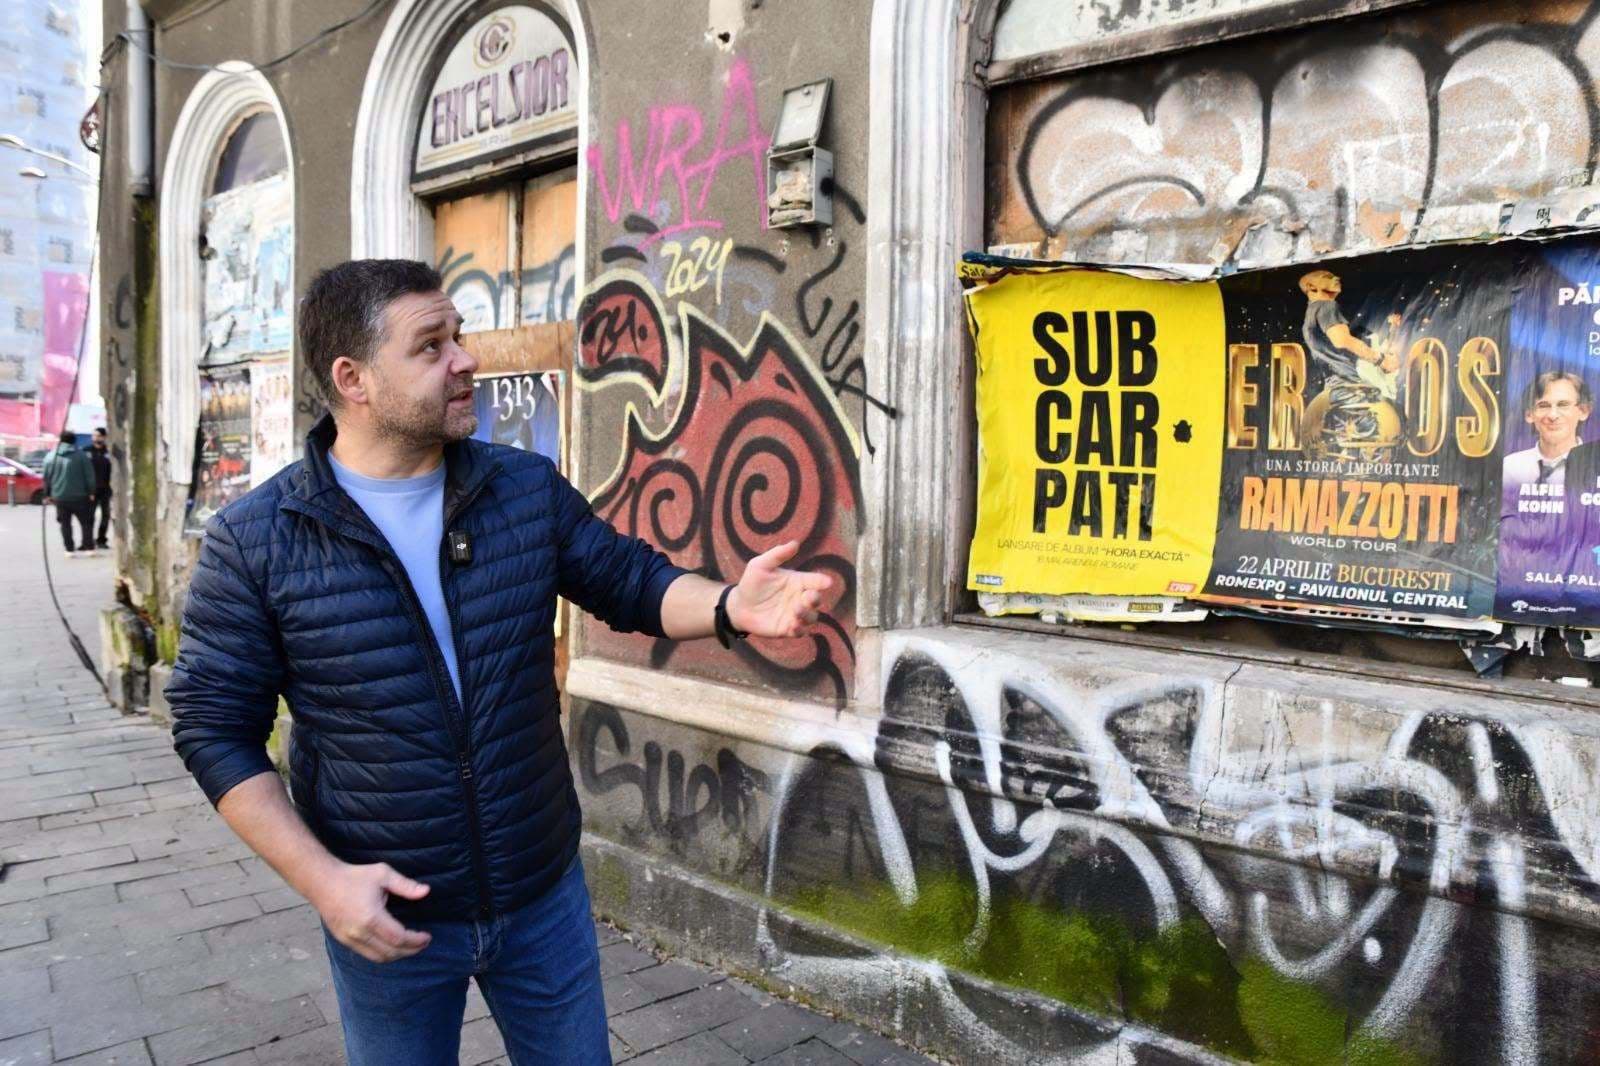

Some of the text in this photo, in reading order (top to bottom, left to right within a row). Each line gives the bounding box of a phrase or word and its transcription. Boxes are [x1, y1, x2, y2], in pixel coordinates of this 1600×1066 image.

[431, 48, 569, 148] EXCELSIOR
[661, 236, 733, 305] 2024
[1032, 310, 1158, 387] SUB
[491, 375, 536, 421] 1313
[1227, 336, 1501, 458] EROS
[1035, 389, 1160, 468] CAR
[1266, 459, 1440, 477] UNA STORIA IMPORTANTE
[1033, 468, 1157, 542] PATI
[1239, 475, 1459, 544] RAMAZZOTTI
[1518, 500, 1564, 514] KOHN
[1519, 483, 1564, 497] ALFIE
[998, 539, 1044, 552] LANSARE
[1046, 543, 1058, 552] DE
[1062, 543, 1099, 554] ALBUM
[1290, 535, 1397, 552] WORLD TOUR
[1215, 574, 1286, 593] ROMEXPO
[1298, 582, 1388, 603] PAVILIONUL
[1392, 591, 1468, 609] CENTRAL
[1236, 555, 1454, 592] 22 APRILIE BUCURESTI
[1525, 572, 1600, 586] SALA PAL
